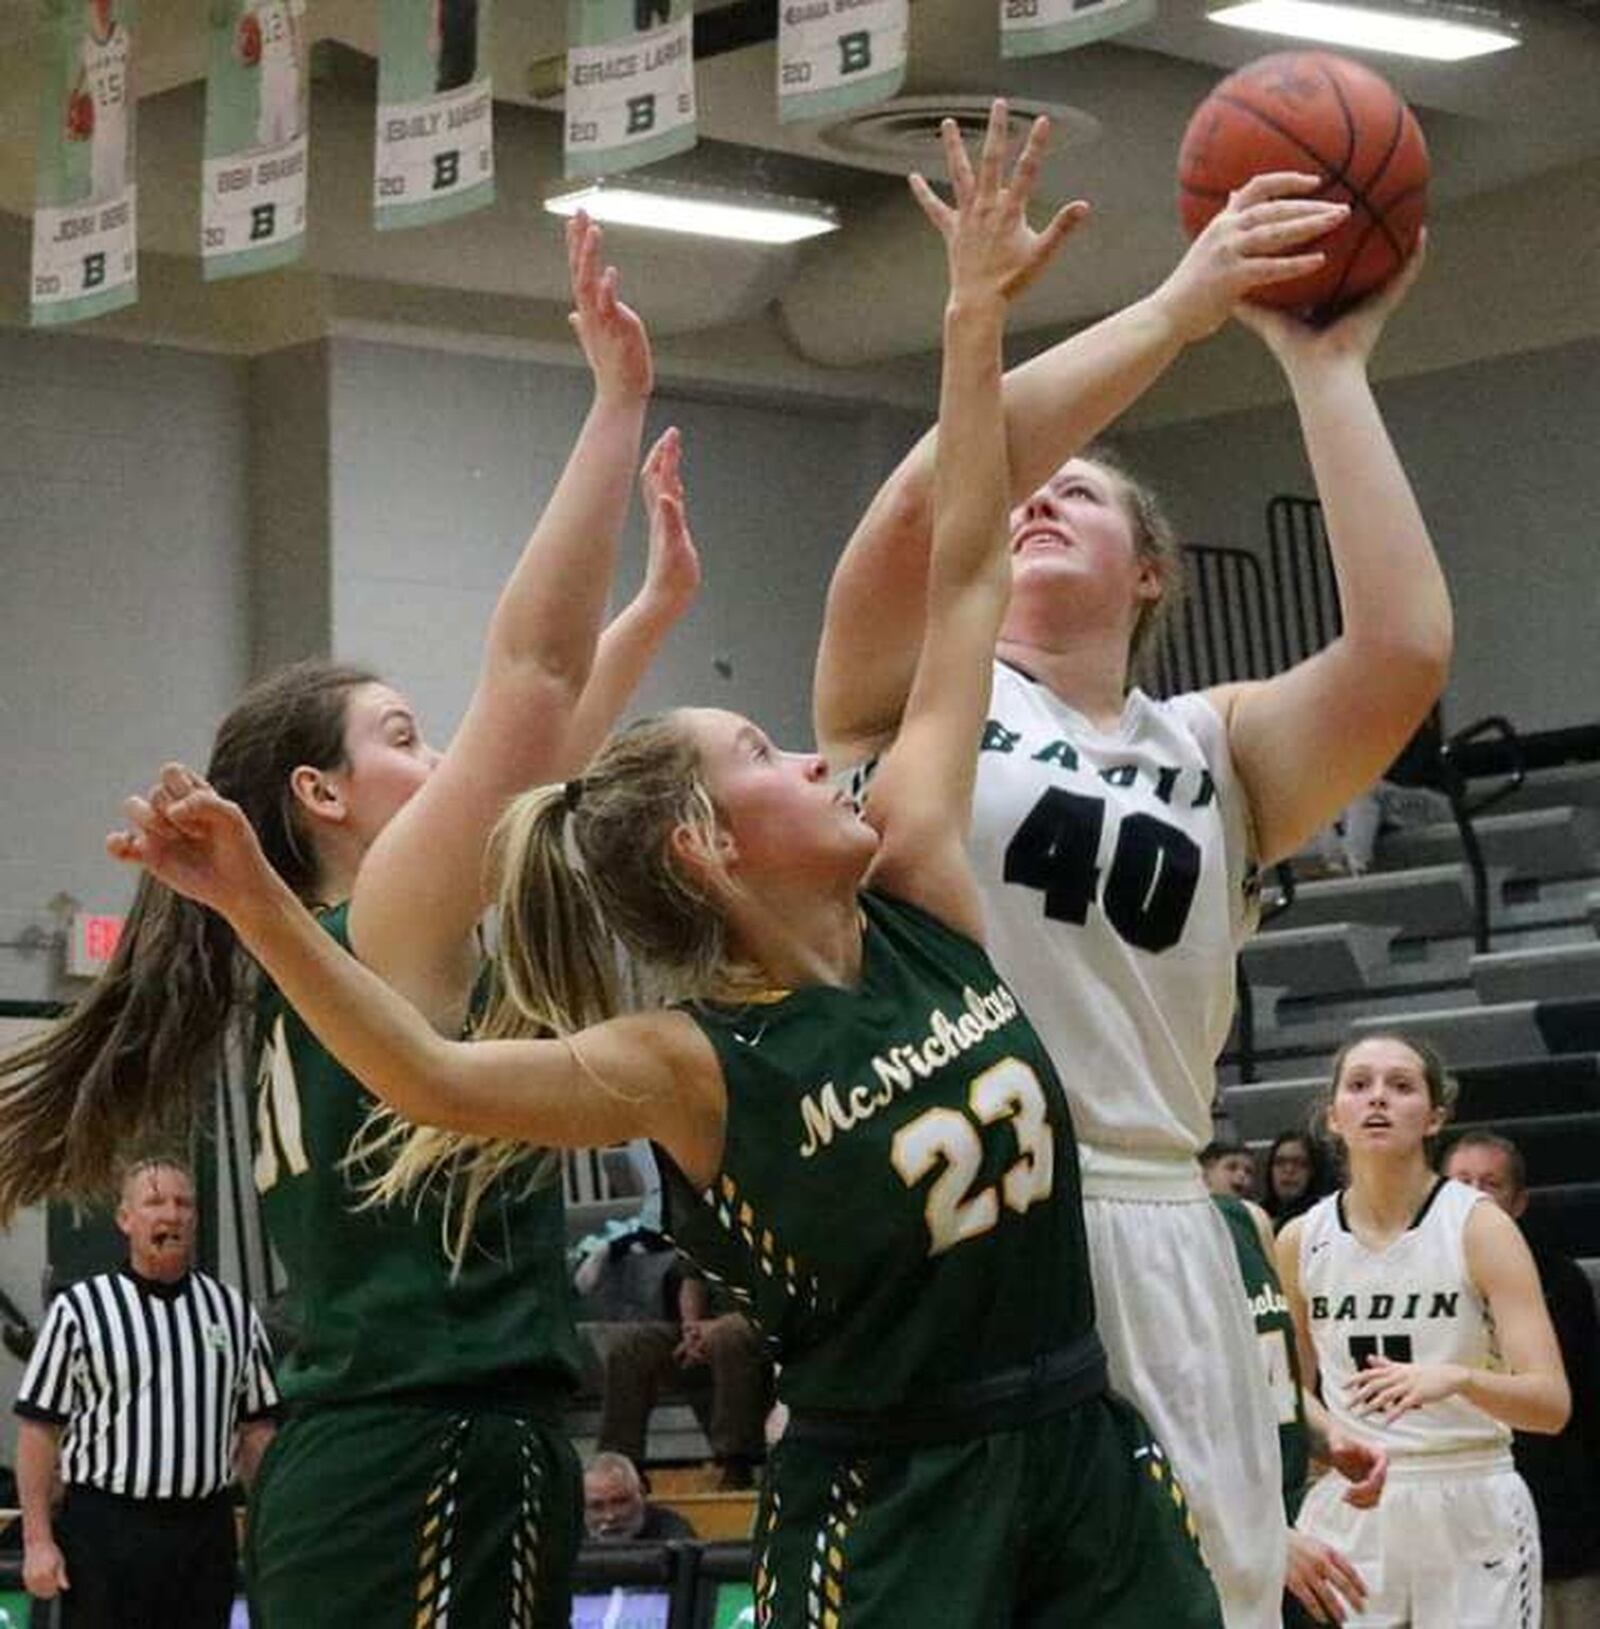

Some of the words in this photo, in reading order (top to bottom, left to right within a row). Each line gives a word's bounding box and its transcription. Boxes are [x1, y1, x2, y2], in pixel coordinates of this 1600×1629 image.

[838, 30, 871, 75] B
[782, 60, 812, 84] 20
[569, 121, 597, 143] 20
[626, 93, 656, 135] B
[378, 176, 405, 197] 20
[432, 151, 460, 191] B
[249, 203, 276, 240] B
[35, 274, 61, 295] 20
[82, 252, 106, 289] B
[1003, 785, 1202, 955] 40
[889, 1056, 1055, 1258] 23
[1311, 1291, 1460, 1321] BADIN
